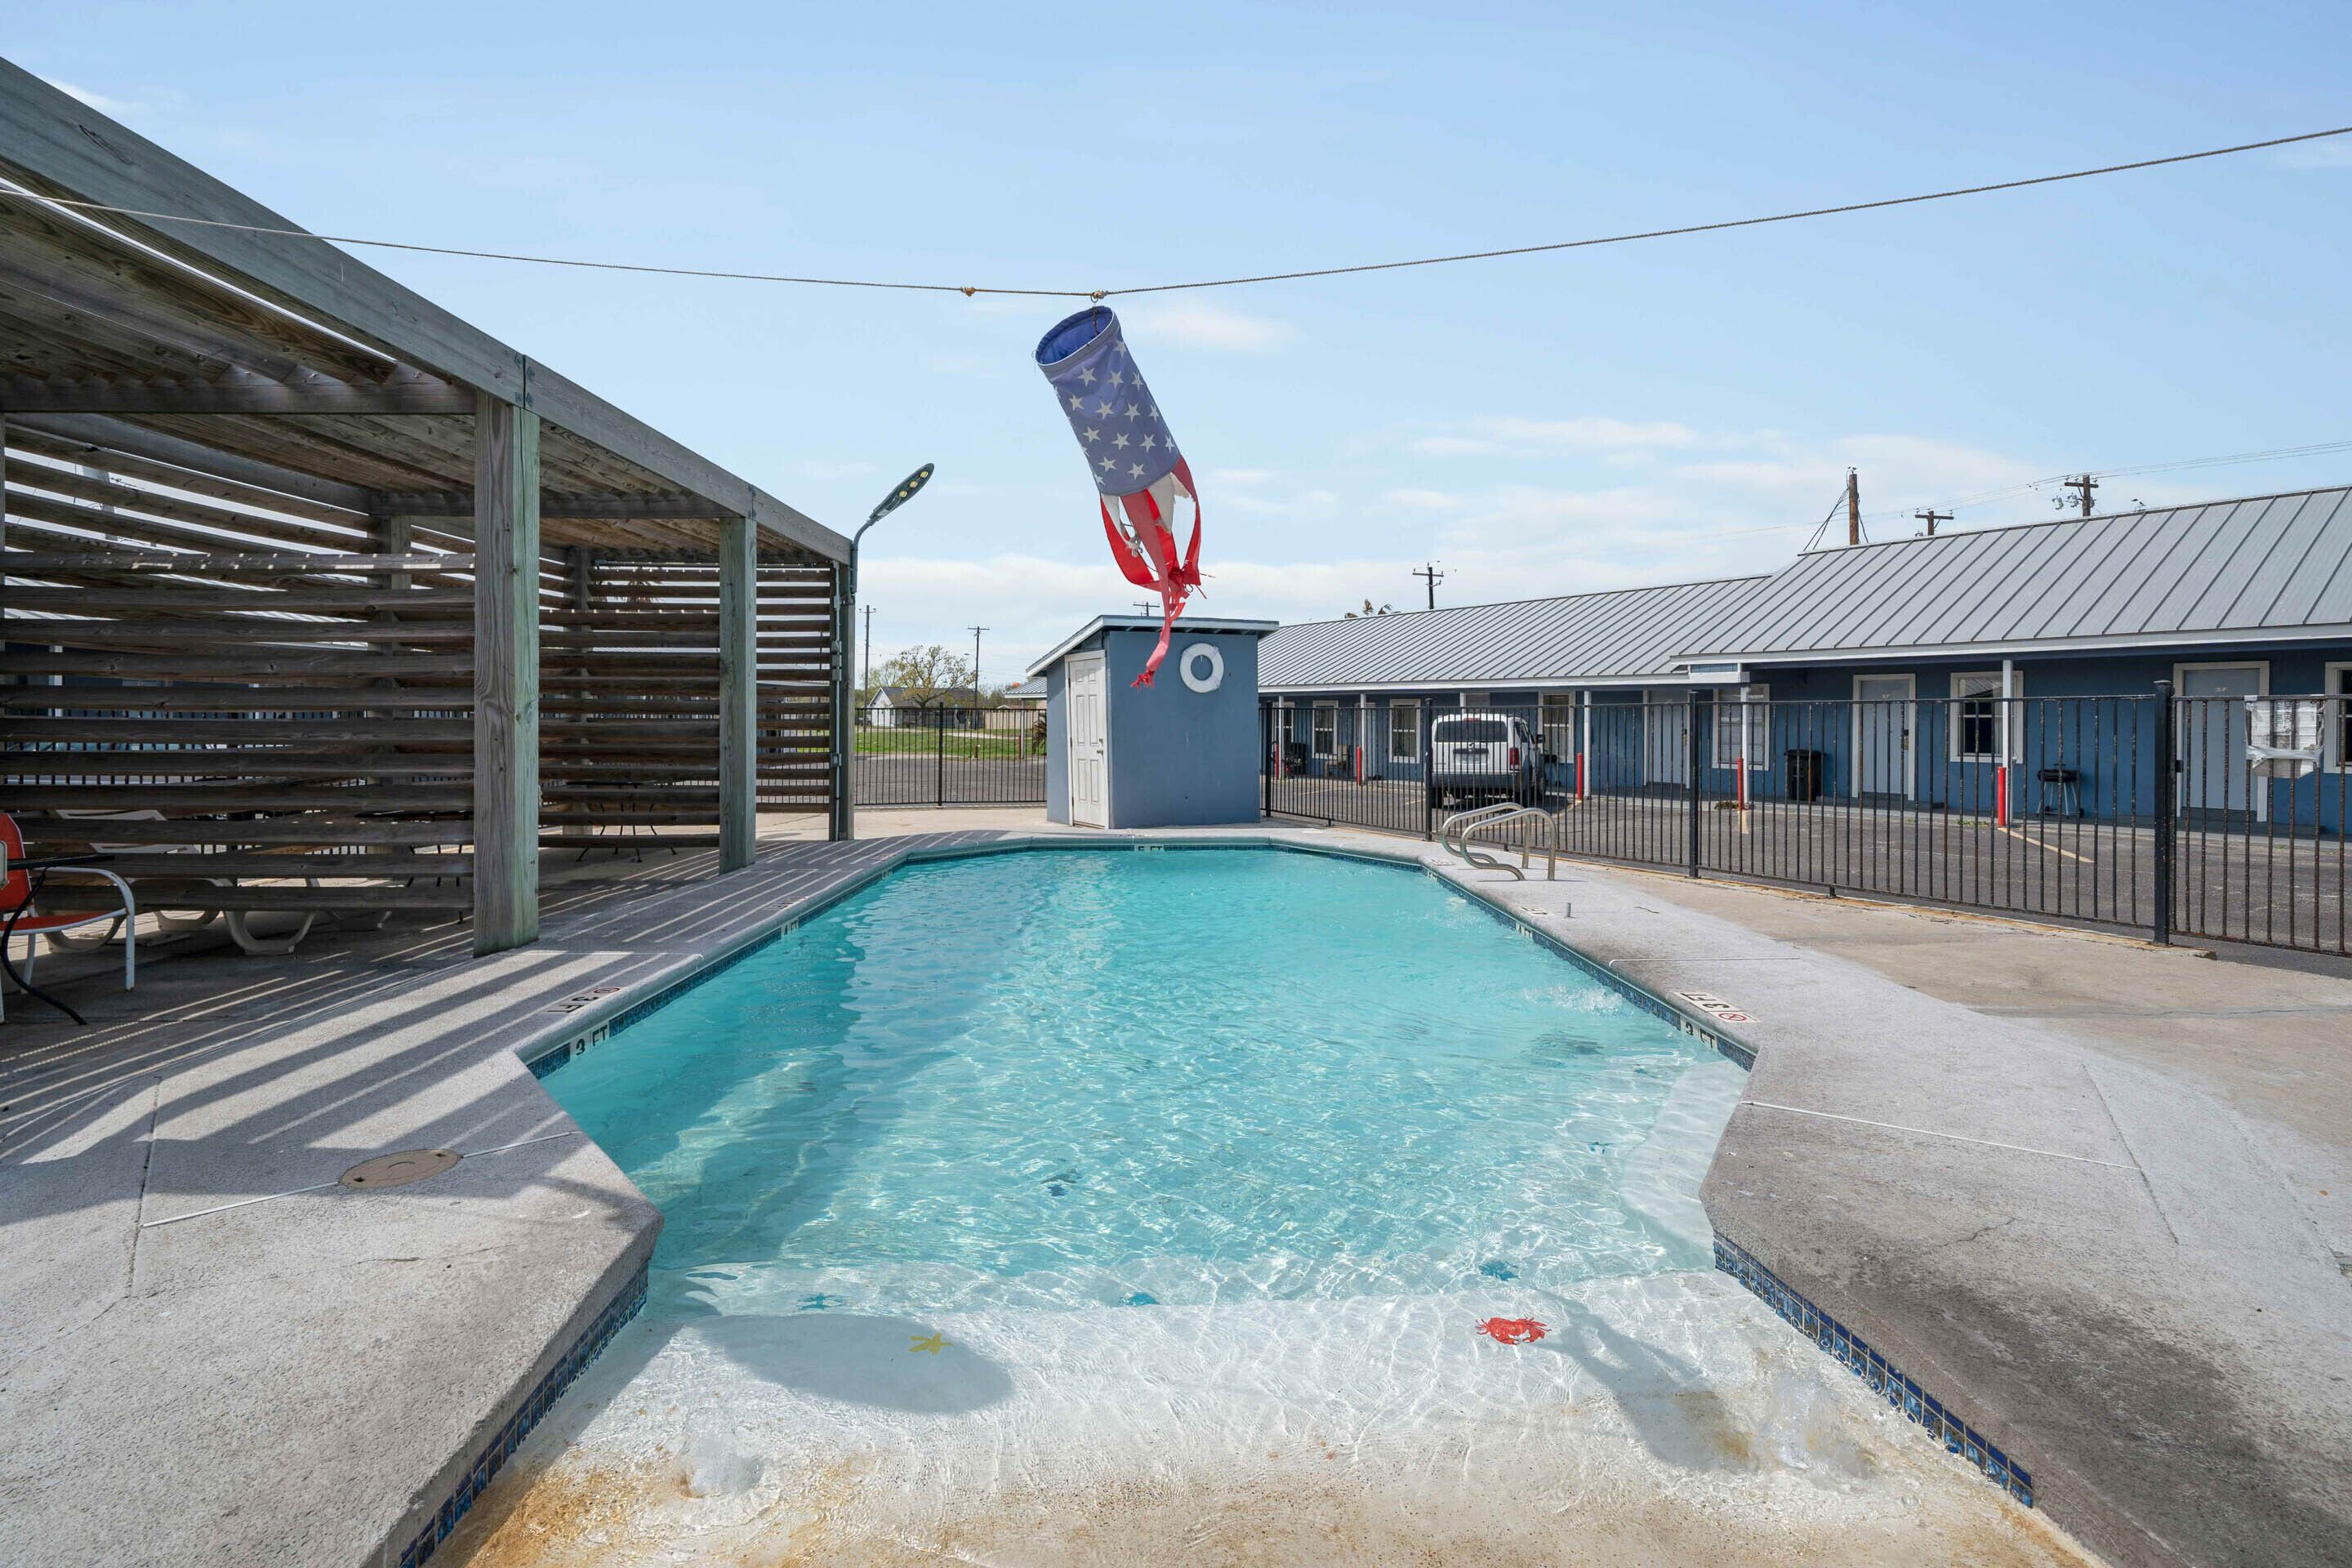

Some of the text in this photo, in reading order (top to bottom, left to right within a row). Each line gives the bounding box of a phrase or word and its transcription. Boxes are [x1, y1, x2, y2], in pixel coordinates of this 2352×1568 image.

[1680, 992, 1717, 1001] FT
[547, 1004, 585, 1013] FT
[576, 1025, 608, 1056] 3 FT
[1686, 1022, 1716, 1049] 3 FT
